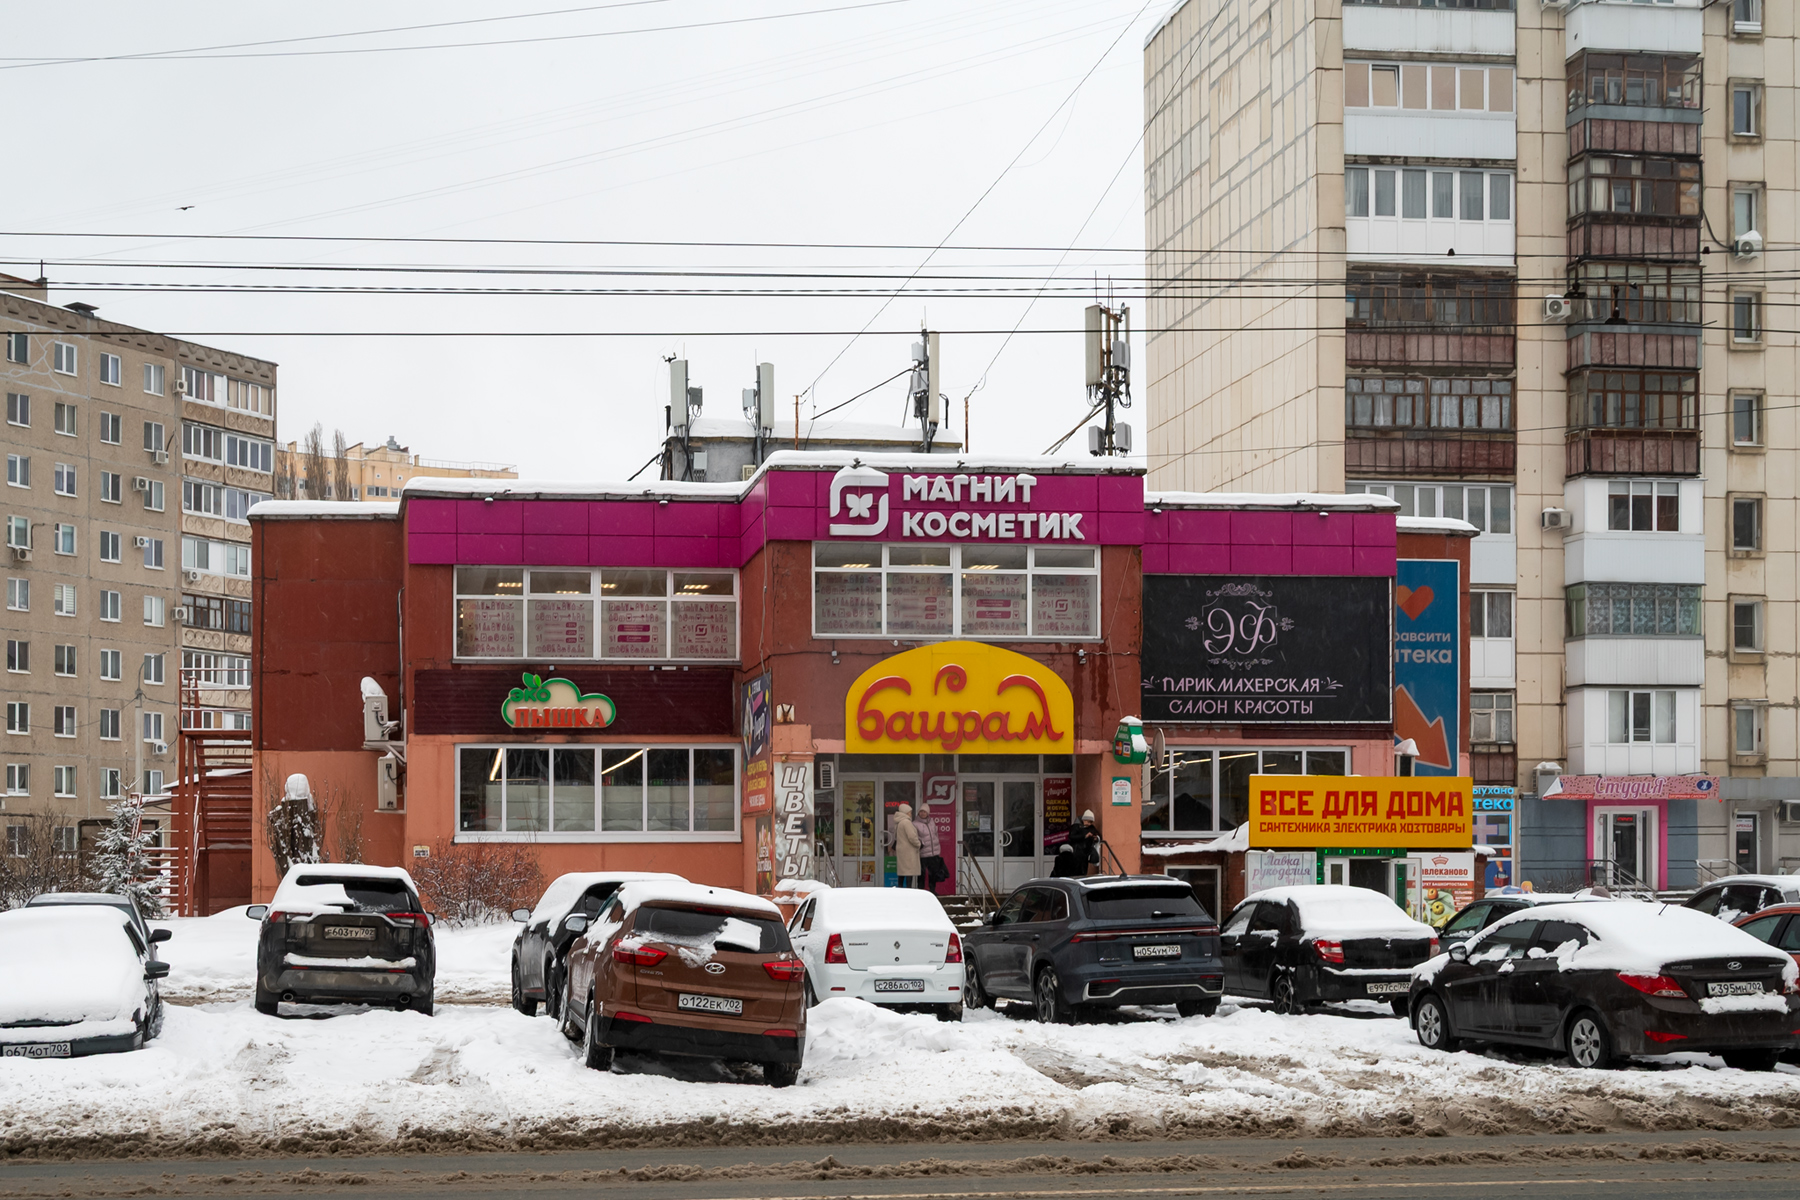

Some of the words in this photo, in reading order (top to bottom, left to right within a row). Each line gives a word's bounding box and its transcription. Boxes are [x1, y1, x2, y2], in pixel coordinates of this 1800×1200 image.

[903, 474, 1037, 503] МАГНИТ
[902, 512, 1085, 540] КОСМЕТИК
[1163, 676, 1320, 693] ПАРИКМАХЕРСКАЯ
[510, 687, 551, 703] ЭКО
[1169, 699, 1228, 714] САЛОН
[1234, 699, 1314, 714] КРАСОТЫ
[514, 707, 608, 727] ПЫШКА
[1260, 790, 1314, 816] ВСЕ
[1322, 791, 1377, 819] ДЛЯ
[1386, 791, 1464, 820] ДОМА
[781, 766, 809, 876] ЦВЕТЫ
[1259, 822, 1330, 833] САНТЕХНИКА
[1333, 822, 1397, 833] ЭЛЕКТРИКА
[1399, 822, 1465, 834] ХОЗТОВАРЫ
[1264, 855, 1300, 866] Лавка
[1252, 867, 1311, 881] рукоделия
